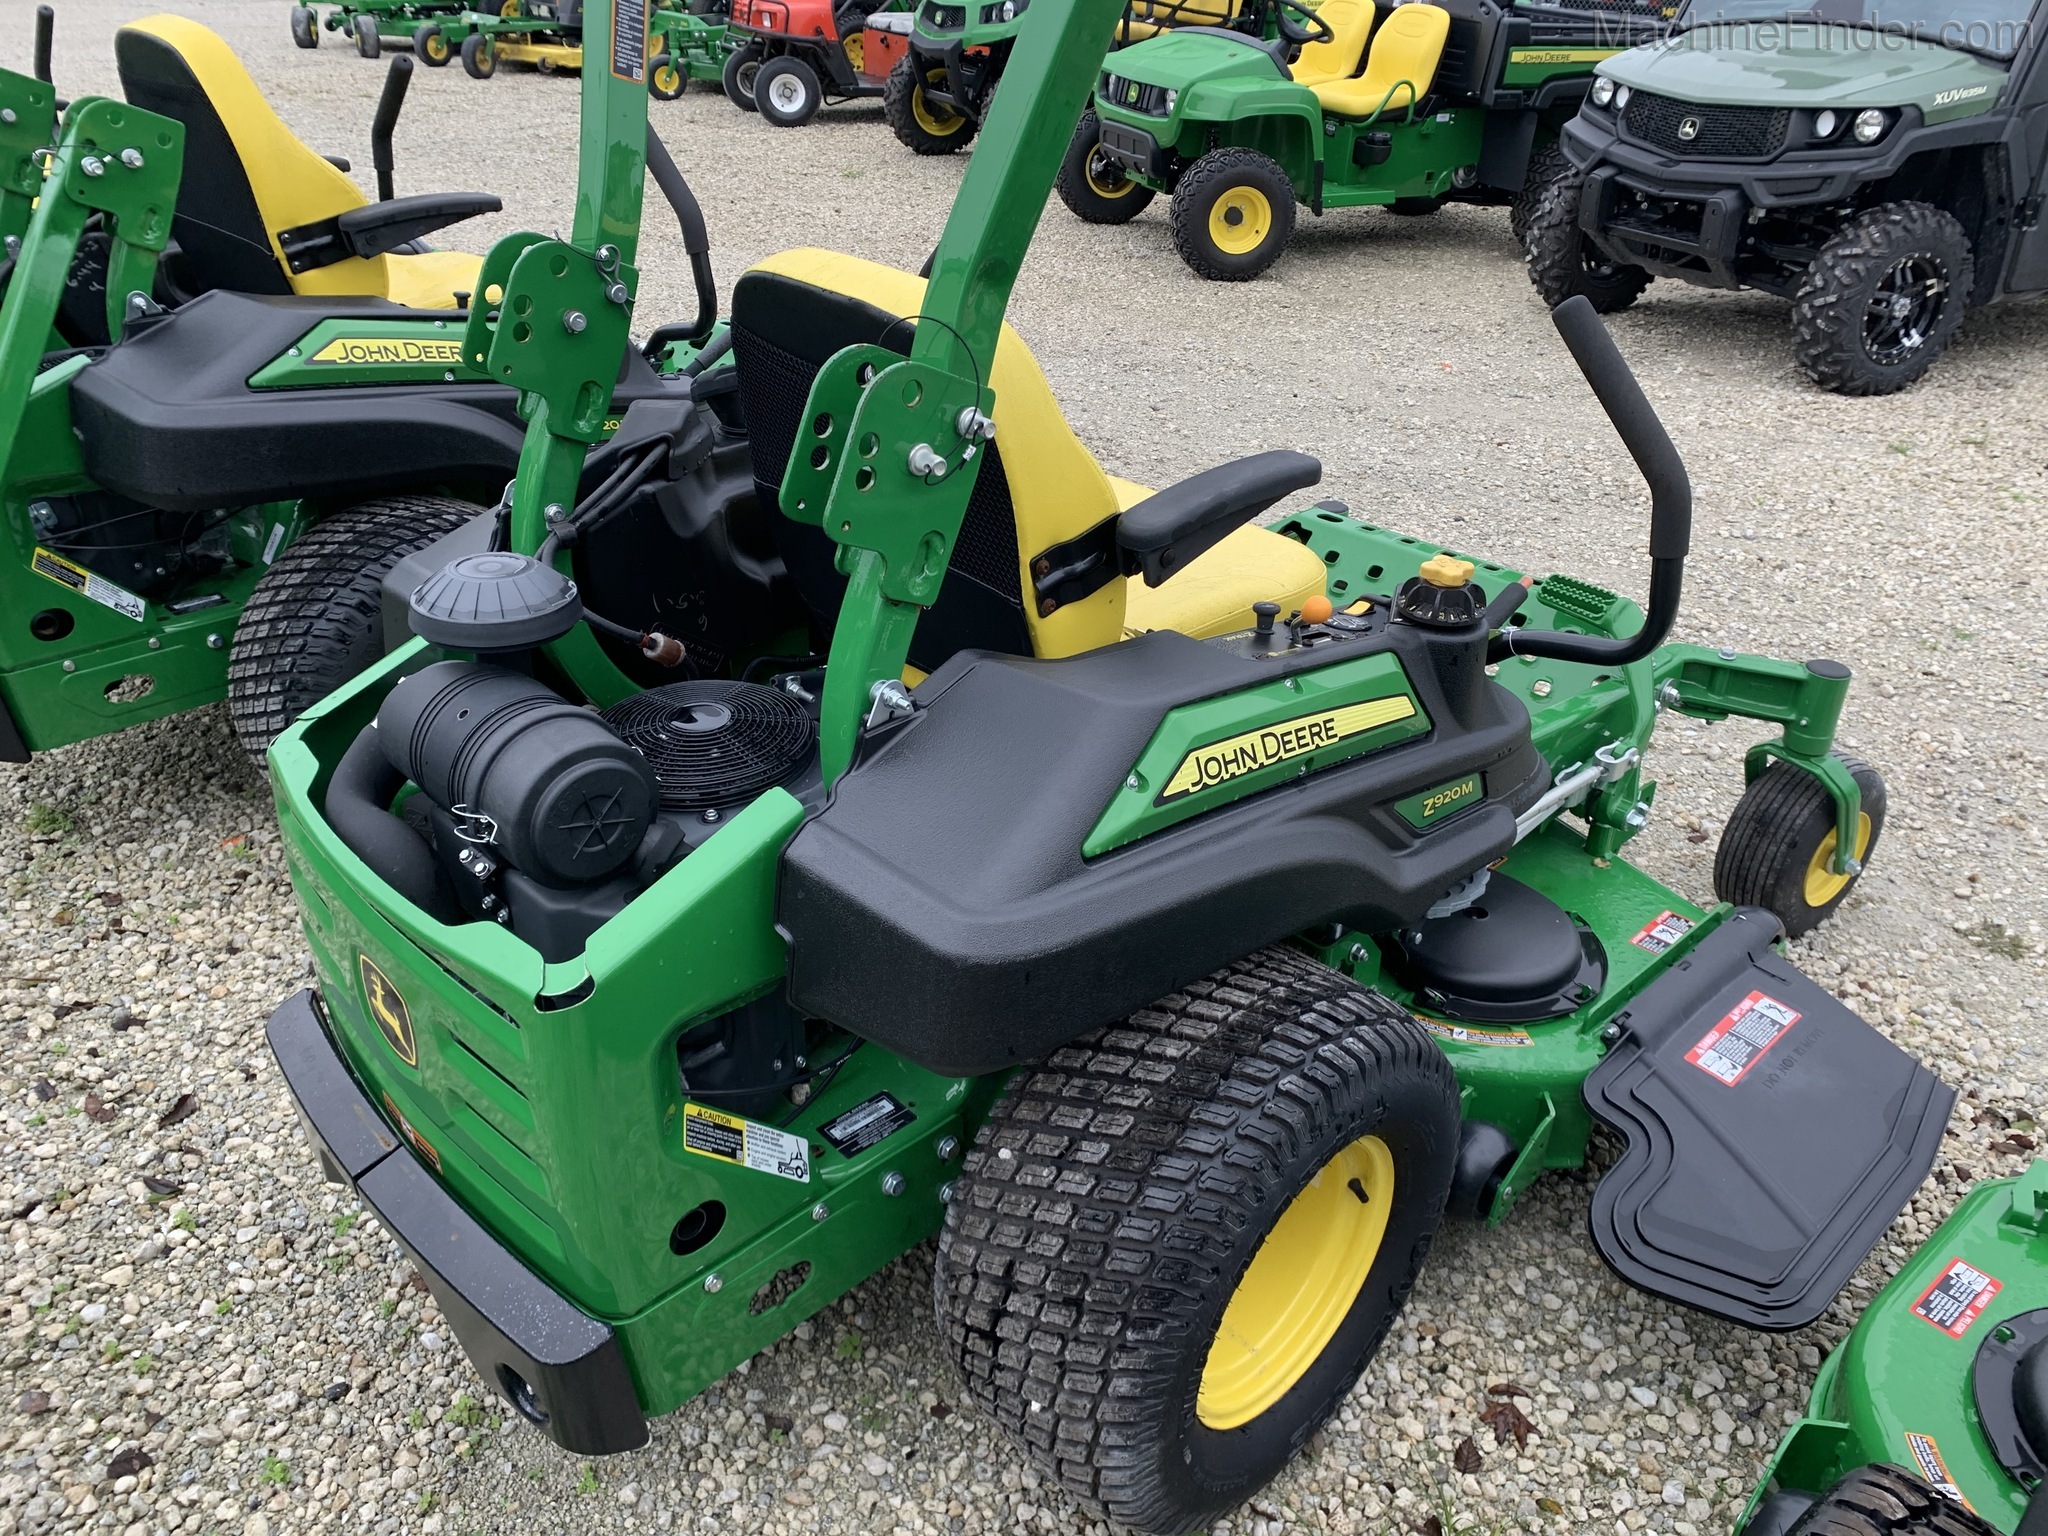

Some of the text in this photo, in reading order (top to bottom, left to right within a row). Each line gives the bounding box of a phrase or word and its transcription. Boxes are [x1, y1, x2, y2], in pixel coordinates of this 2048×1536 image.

[1520, 52, 1572, 63] JOHN DEERE
[338, 342, 461, 361] JOHN DEER
[1190, 717, 1339, 788] JOHN DEERE
[1423, 780, 1473, 817] Z920M
[703, 1110, 732, 1126] CAUTION
